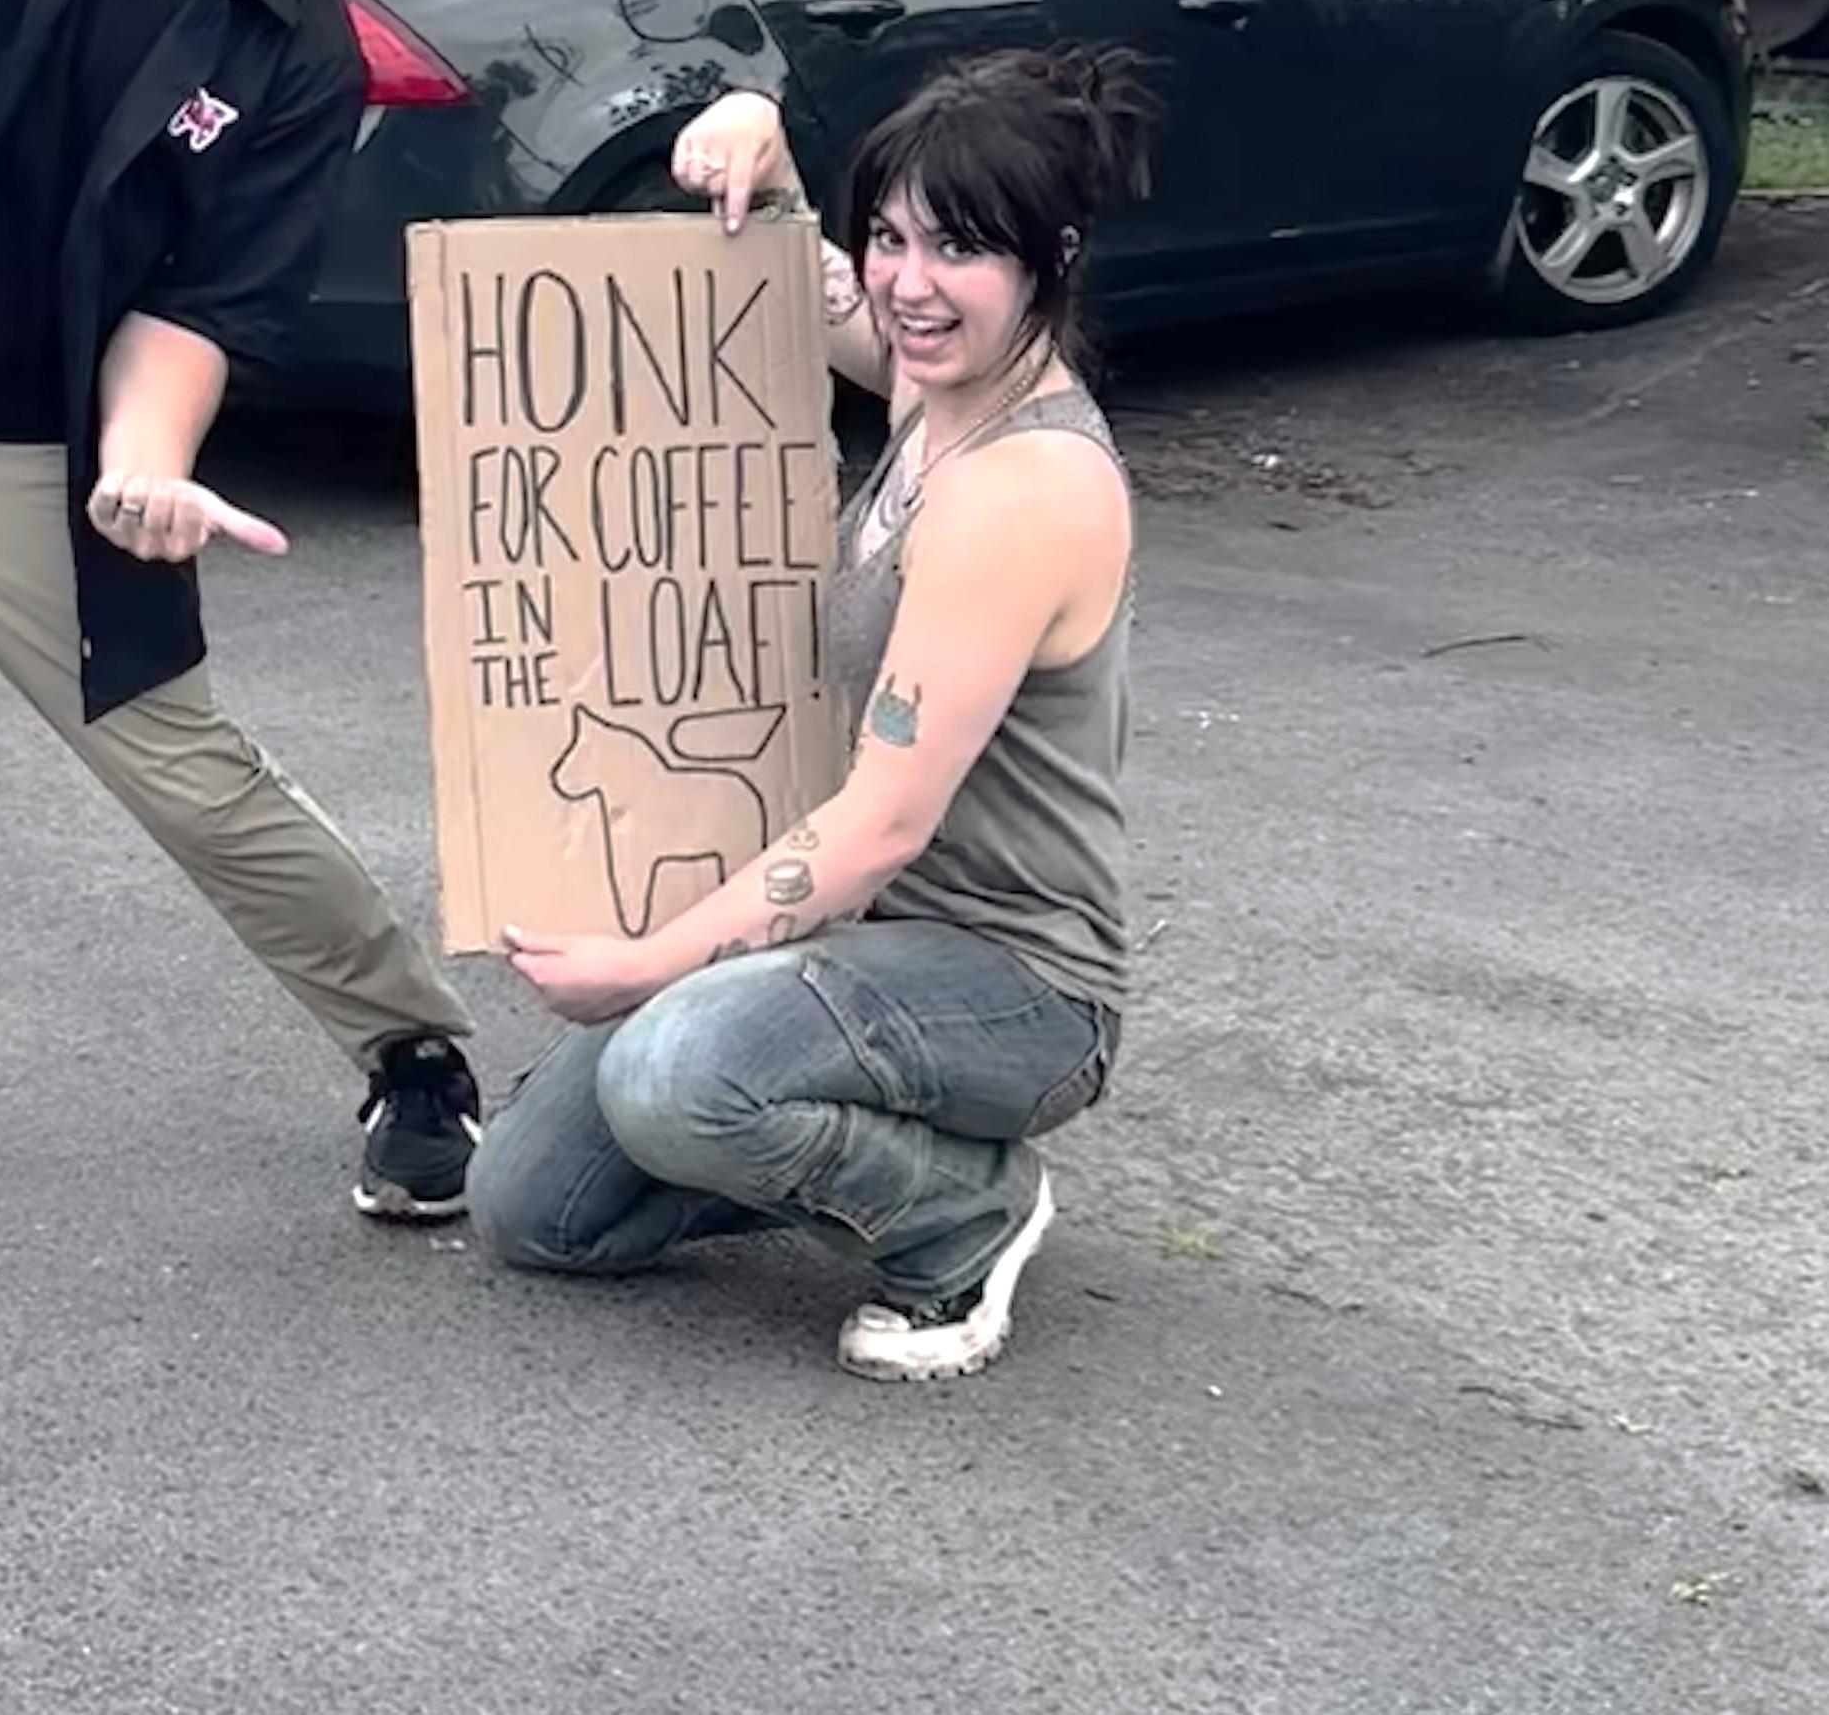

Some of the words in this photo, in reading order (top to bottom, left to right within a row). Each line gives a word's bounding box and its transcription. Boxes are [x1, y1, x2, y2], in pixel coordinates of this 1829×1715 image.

[460, 267, 777, 435] HONK
[470, 444, 579, 567] FOR
[590, 440, 822, 574] COFFEE
[462, 574, 554, 648] IN
[600, 576, 823, 708] LOAF!
[470, 651, 562, 708] THE
